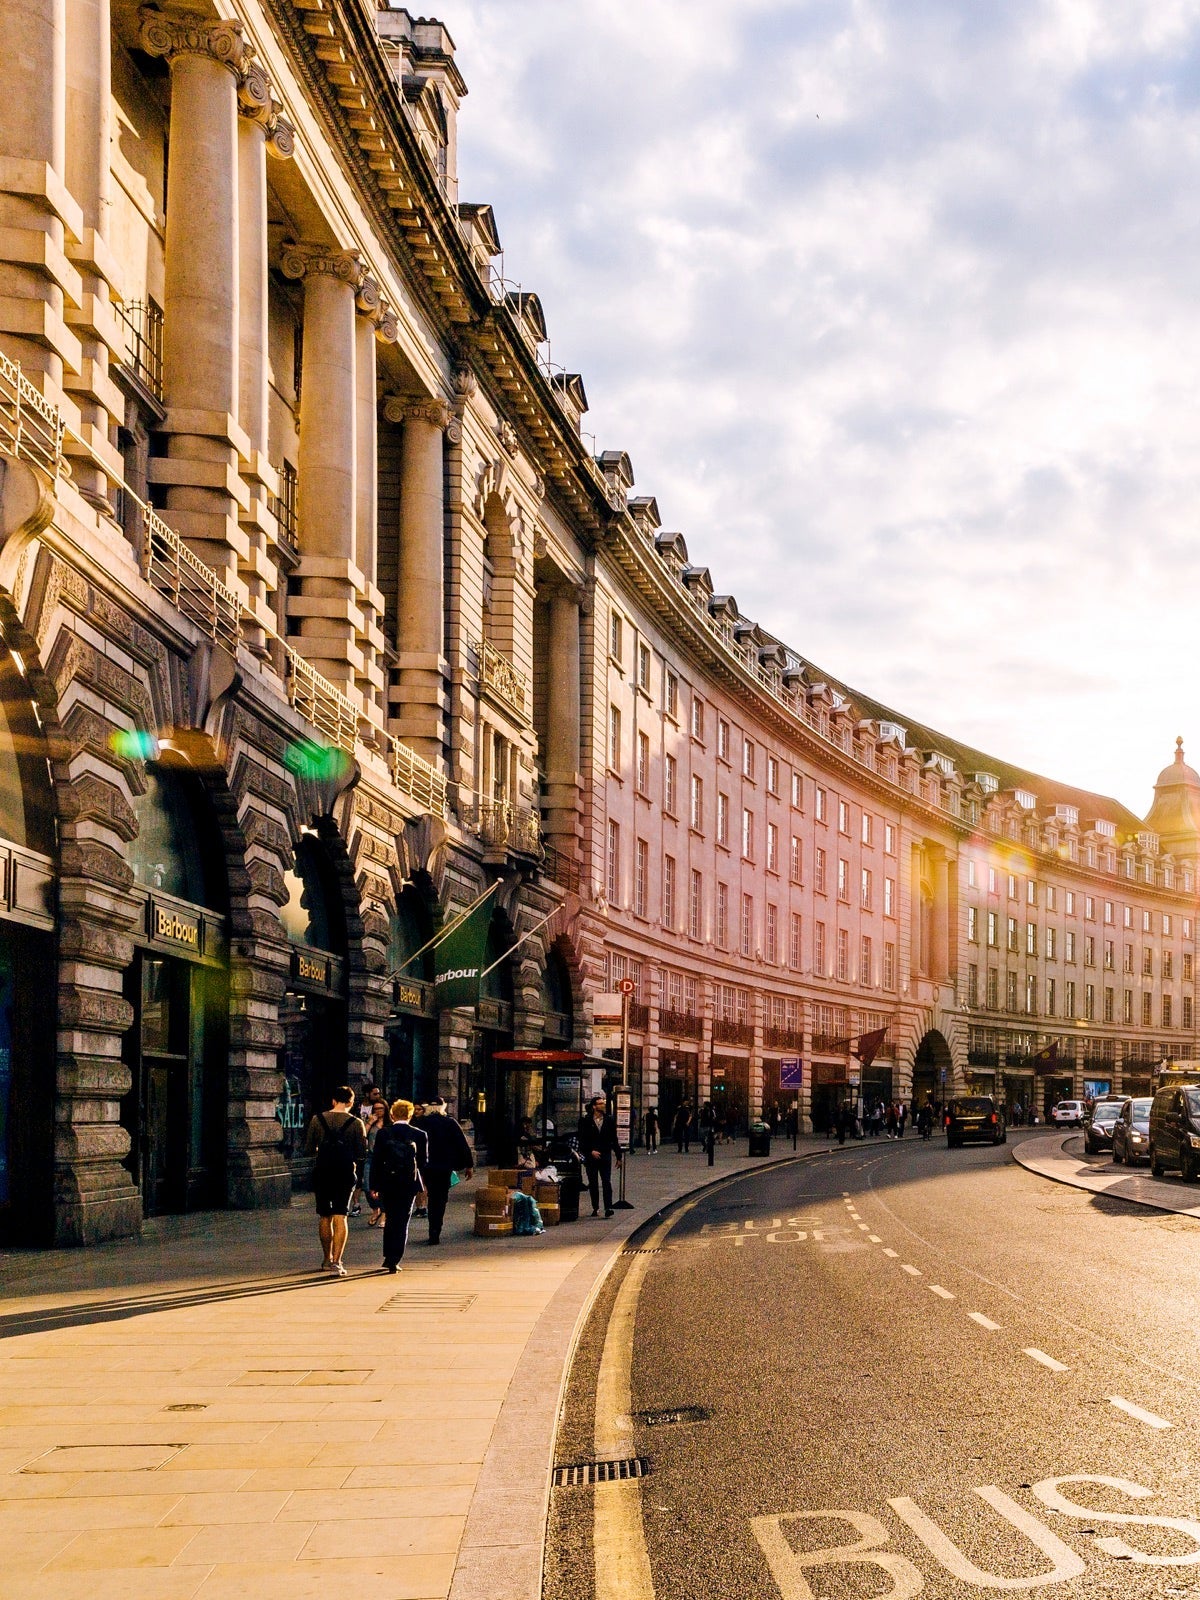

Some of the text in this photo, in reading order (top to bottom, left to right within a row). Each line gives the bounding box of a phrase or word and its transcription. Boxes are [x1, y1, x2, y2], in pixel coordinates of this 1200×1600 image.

[157, 910, 198, 943] Barbour
[299, 957, 326, 981] Barbour
[400, 986, 421, 1005] Barbour
[623, 981, 633, 992] D
[276, 1103, 305, 1129] SALE
[700, 1216, 824, 1234] BUS
